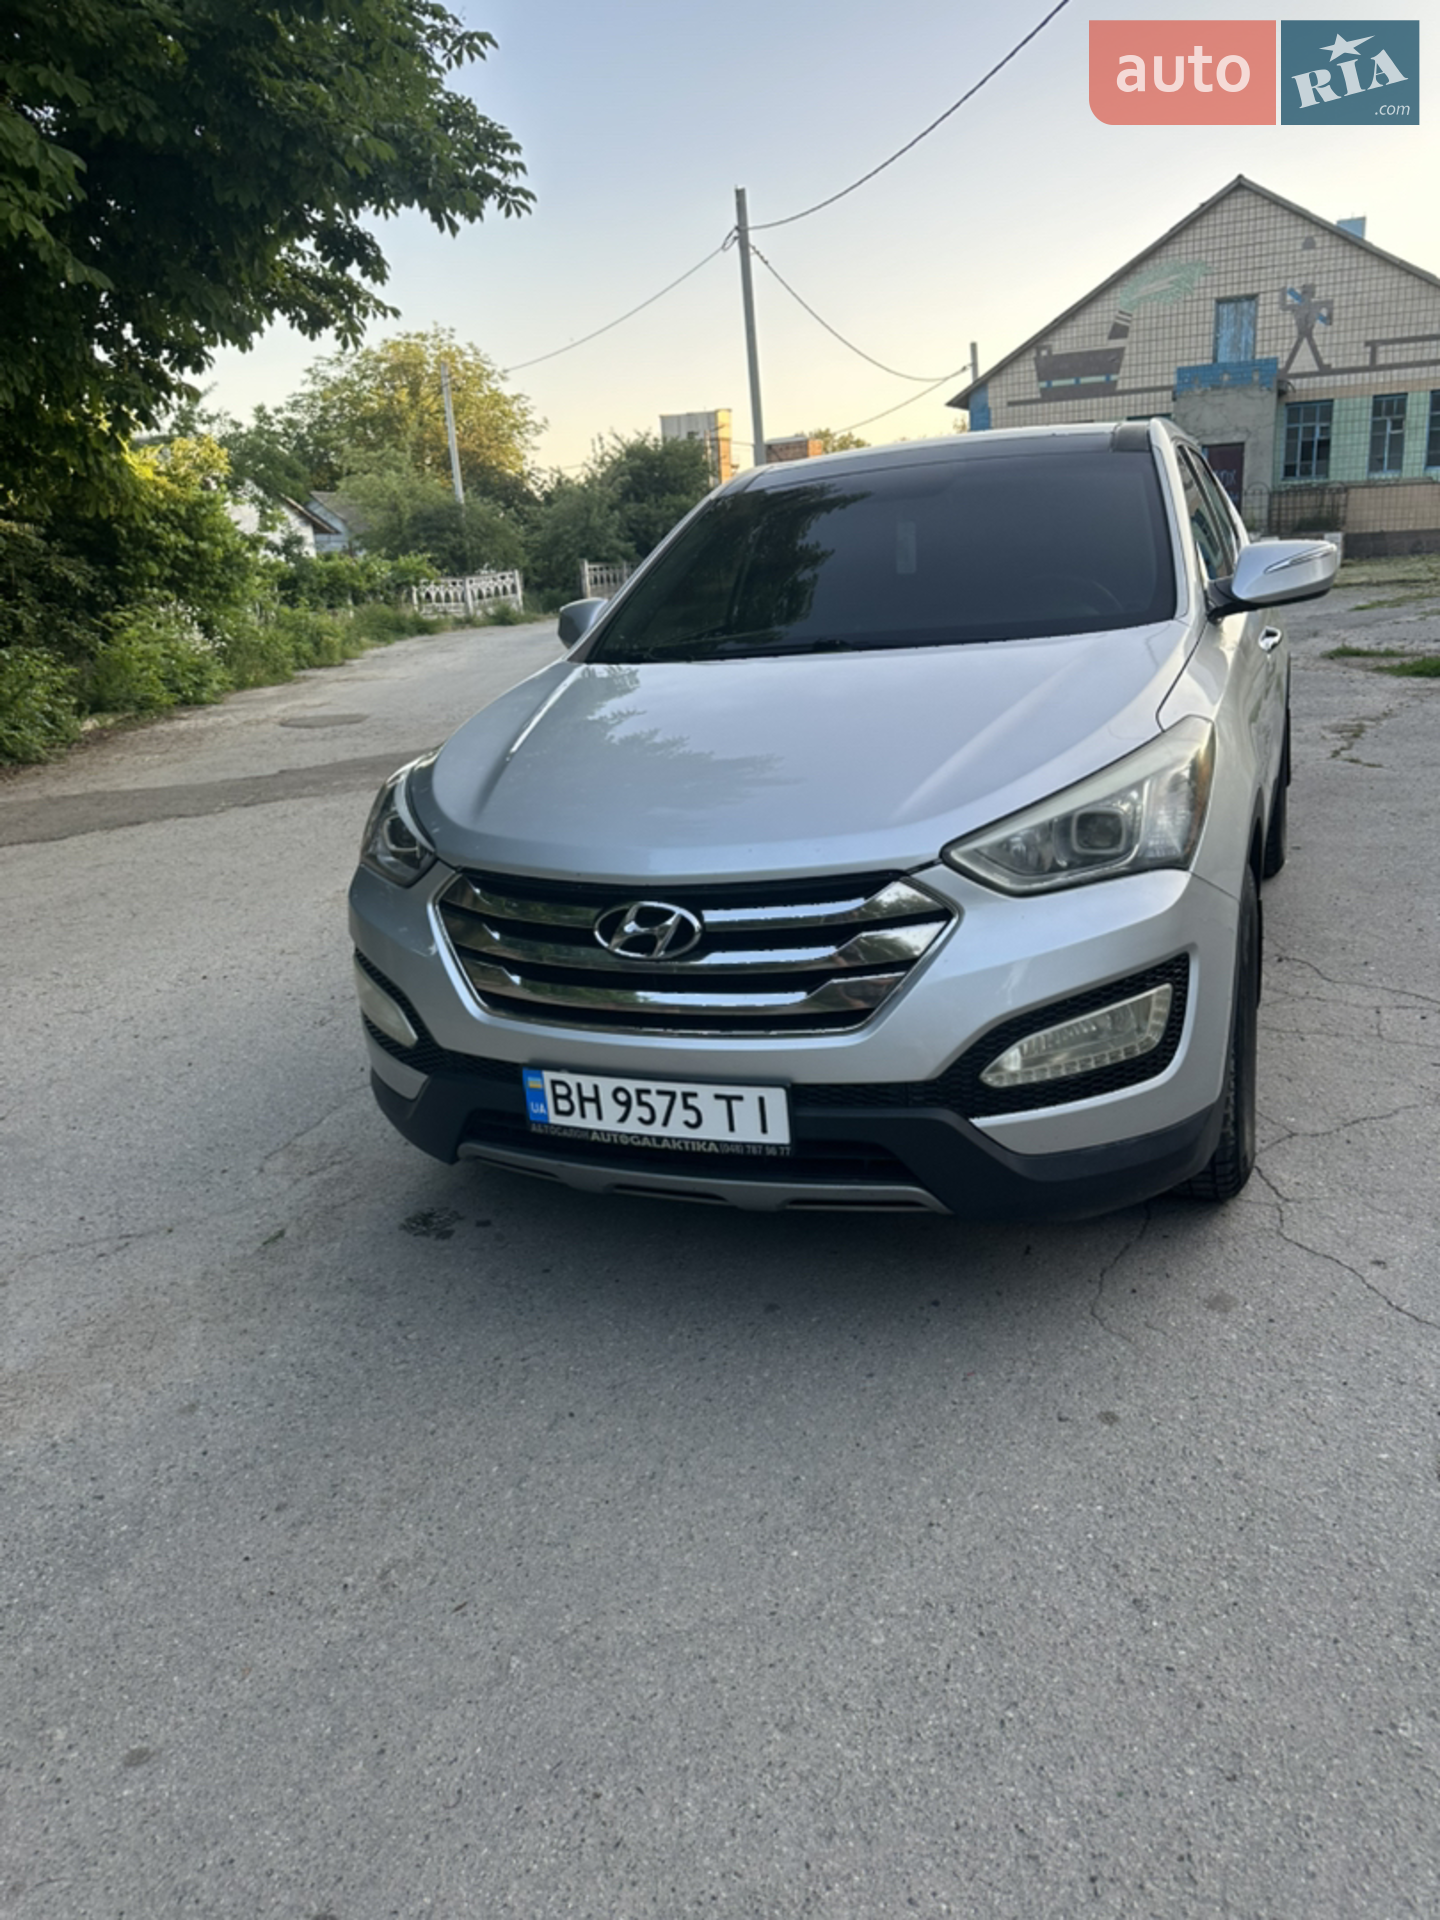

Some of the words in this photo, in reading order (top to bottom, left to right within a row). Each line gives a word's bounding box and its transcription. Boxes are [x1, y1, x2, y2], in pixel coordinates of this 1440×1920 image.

[530, 1102, 547, 1115] UA
[549, 1079, 603, 1121] BH
[612, 1086, 703, 1130] 9575
[590, 1130, 719, 1153] AUTOGALAKTIKA
